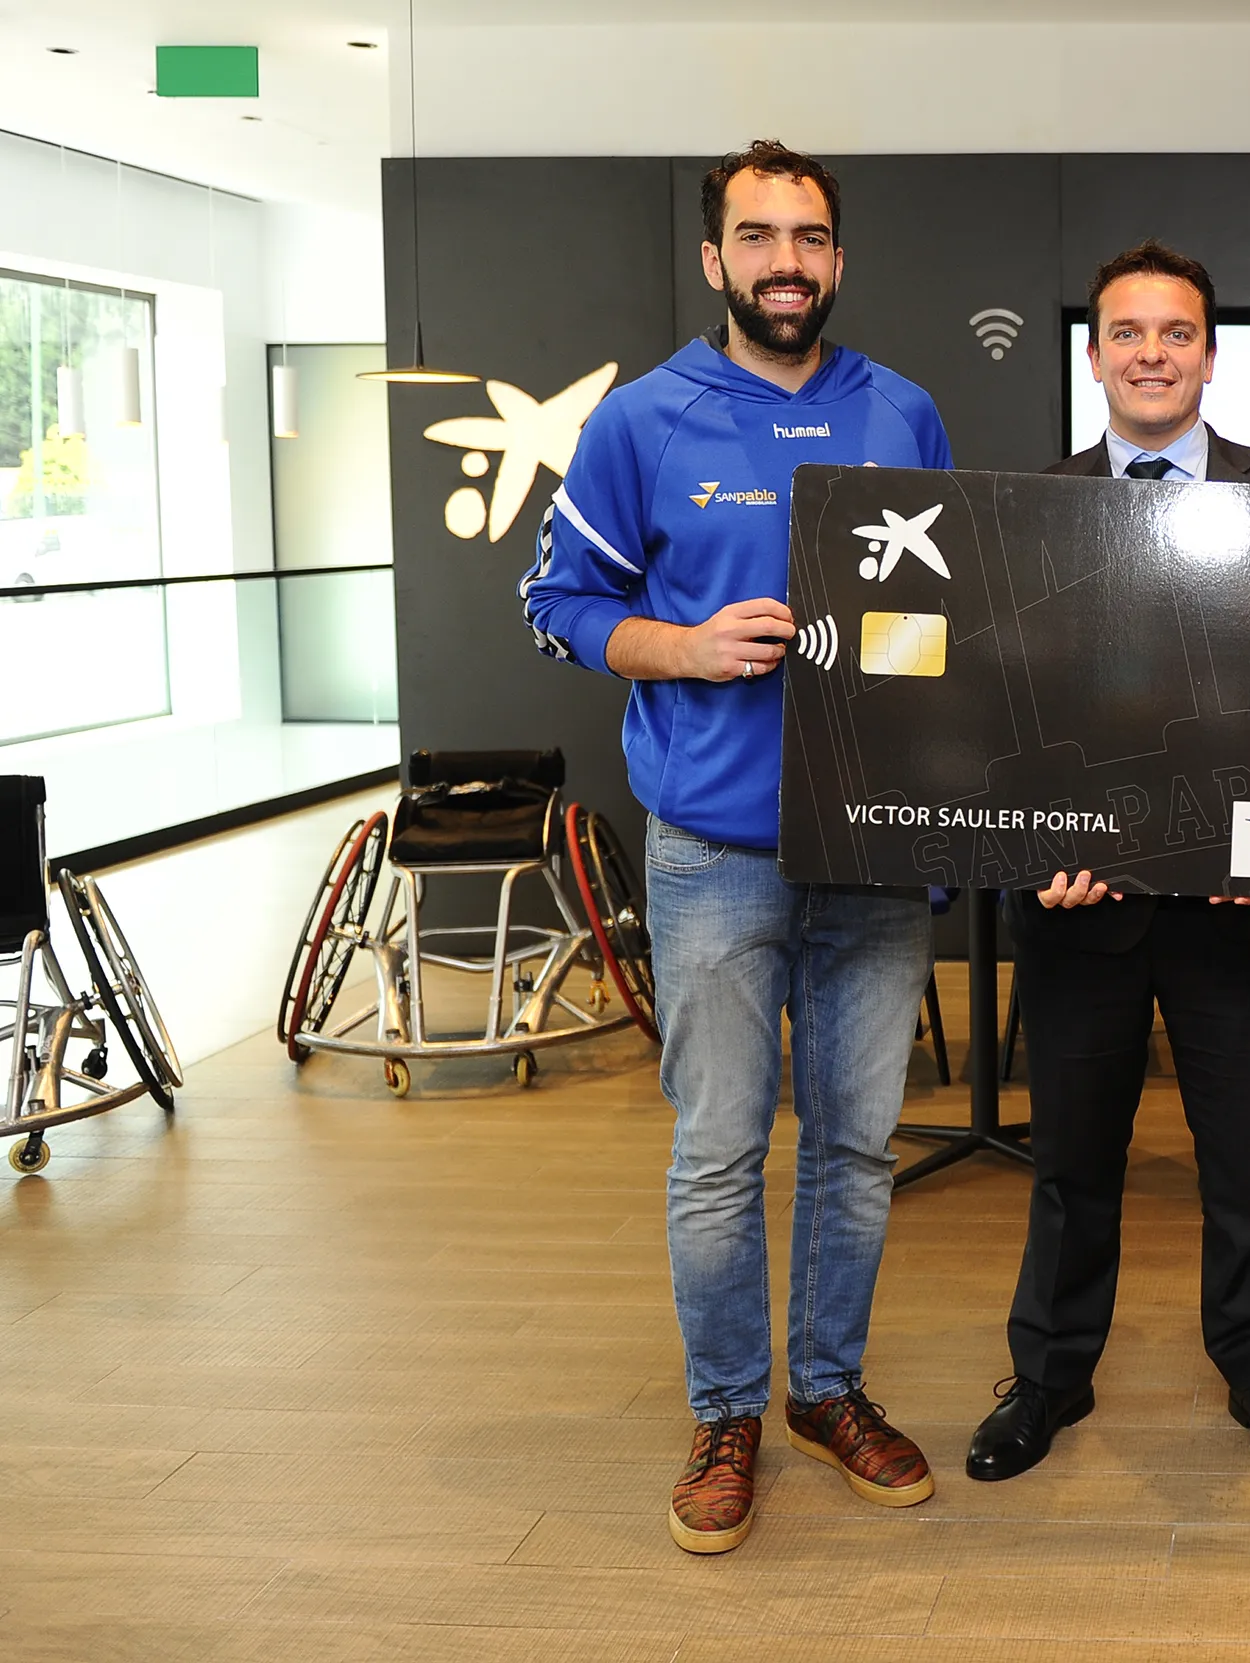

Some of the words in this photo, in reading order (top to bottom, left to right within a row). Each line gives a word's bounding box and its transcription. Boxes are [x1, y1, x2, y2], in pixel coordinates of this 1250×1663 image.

[773, 422, 831, 439] hummel
[845, 804, 930, 826] VICTOR
[938, 807, 1025, 830] SAULER
[1032, 811, 1121, 834] PORTAL
